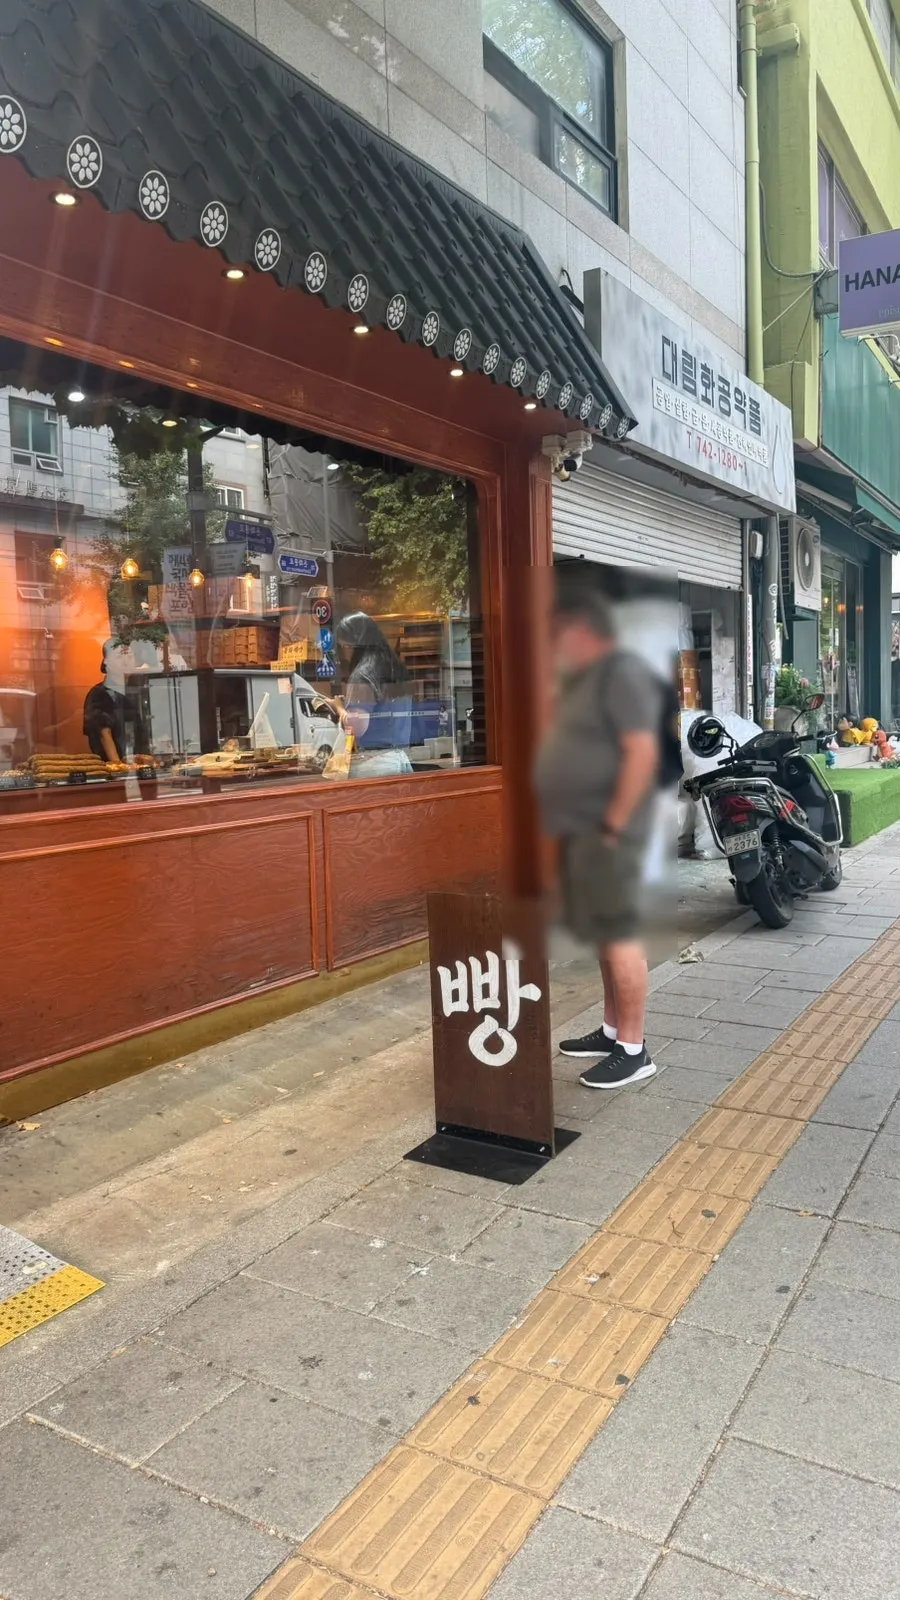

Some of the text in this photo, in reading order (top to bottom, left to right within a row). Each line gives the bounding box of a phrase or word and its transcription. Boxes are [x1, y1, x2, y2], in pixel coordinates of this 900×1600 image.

[662, 335, 761, 436] 대림화공약품
[734, 838, 758, 850] 2376
[437, 937, 541, 1066] 빵
